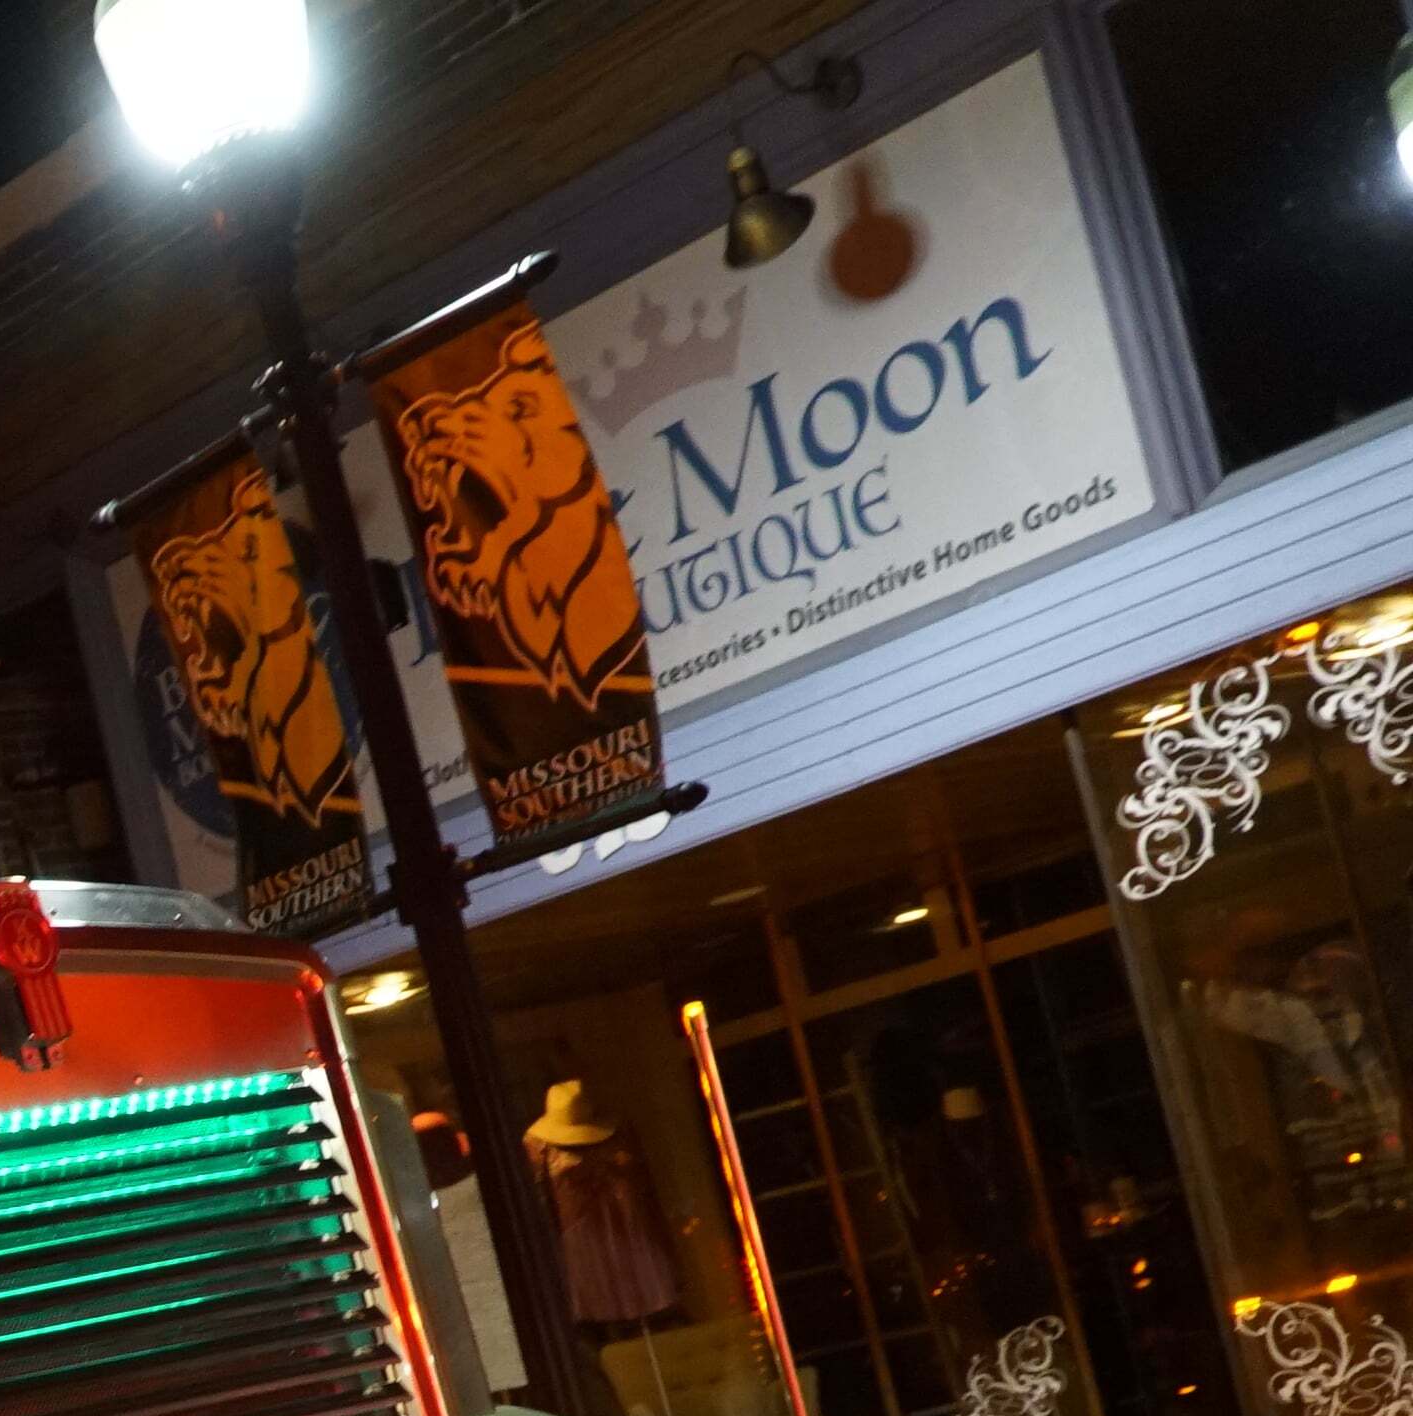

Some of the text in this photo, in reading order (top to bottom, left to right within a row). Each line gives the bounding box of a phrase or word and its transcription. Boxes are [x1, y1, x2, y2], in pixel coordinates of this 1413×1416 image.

[653, 296, 1053, 544] Moon
[636, 455, 901, 634] UTIQUE
[658, 626, 766, 688] cessories
[786, 559, 926, 635] Distinctive
[932, 519, 1015, 574] Home
[1021, 474, 1118, 532] Goods
[487, 718, 651, 799] MISSOURI
[496, 745, 654, 831] SOUTHERN
[246, 835, 363, 909] MISSOURI
[247, 862, 364, 932] SOUTHERN
